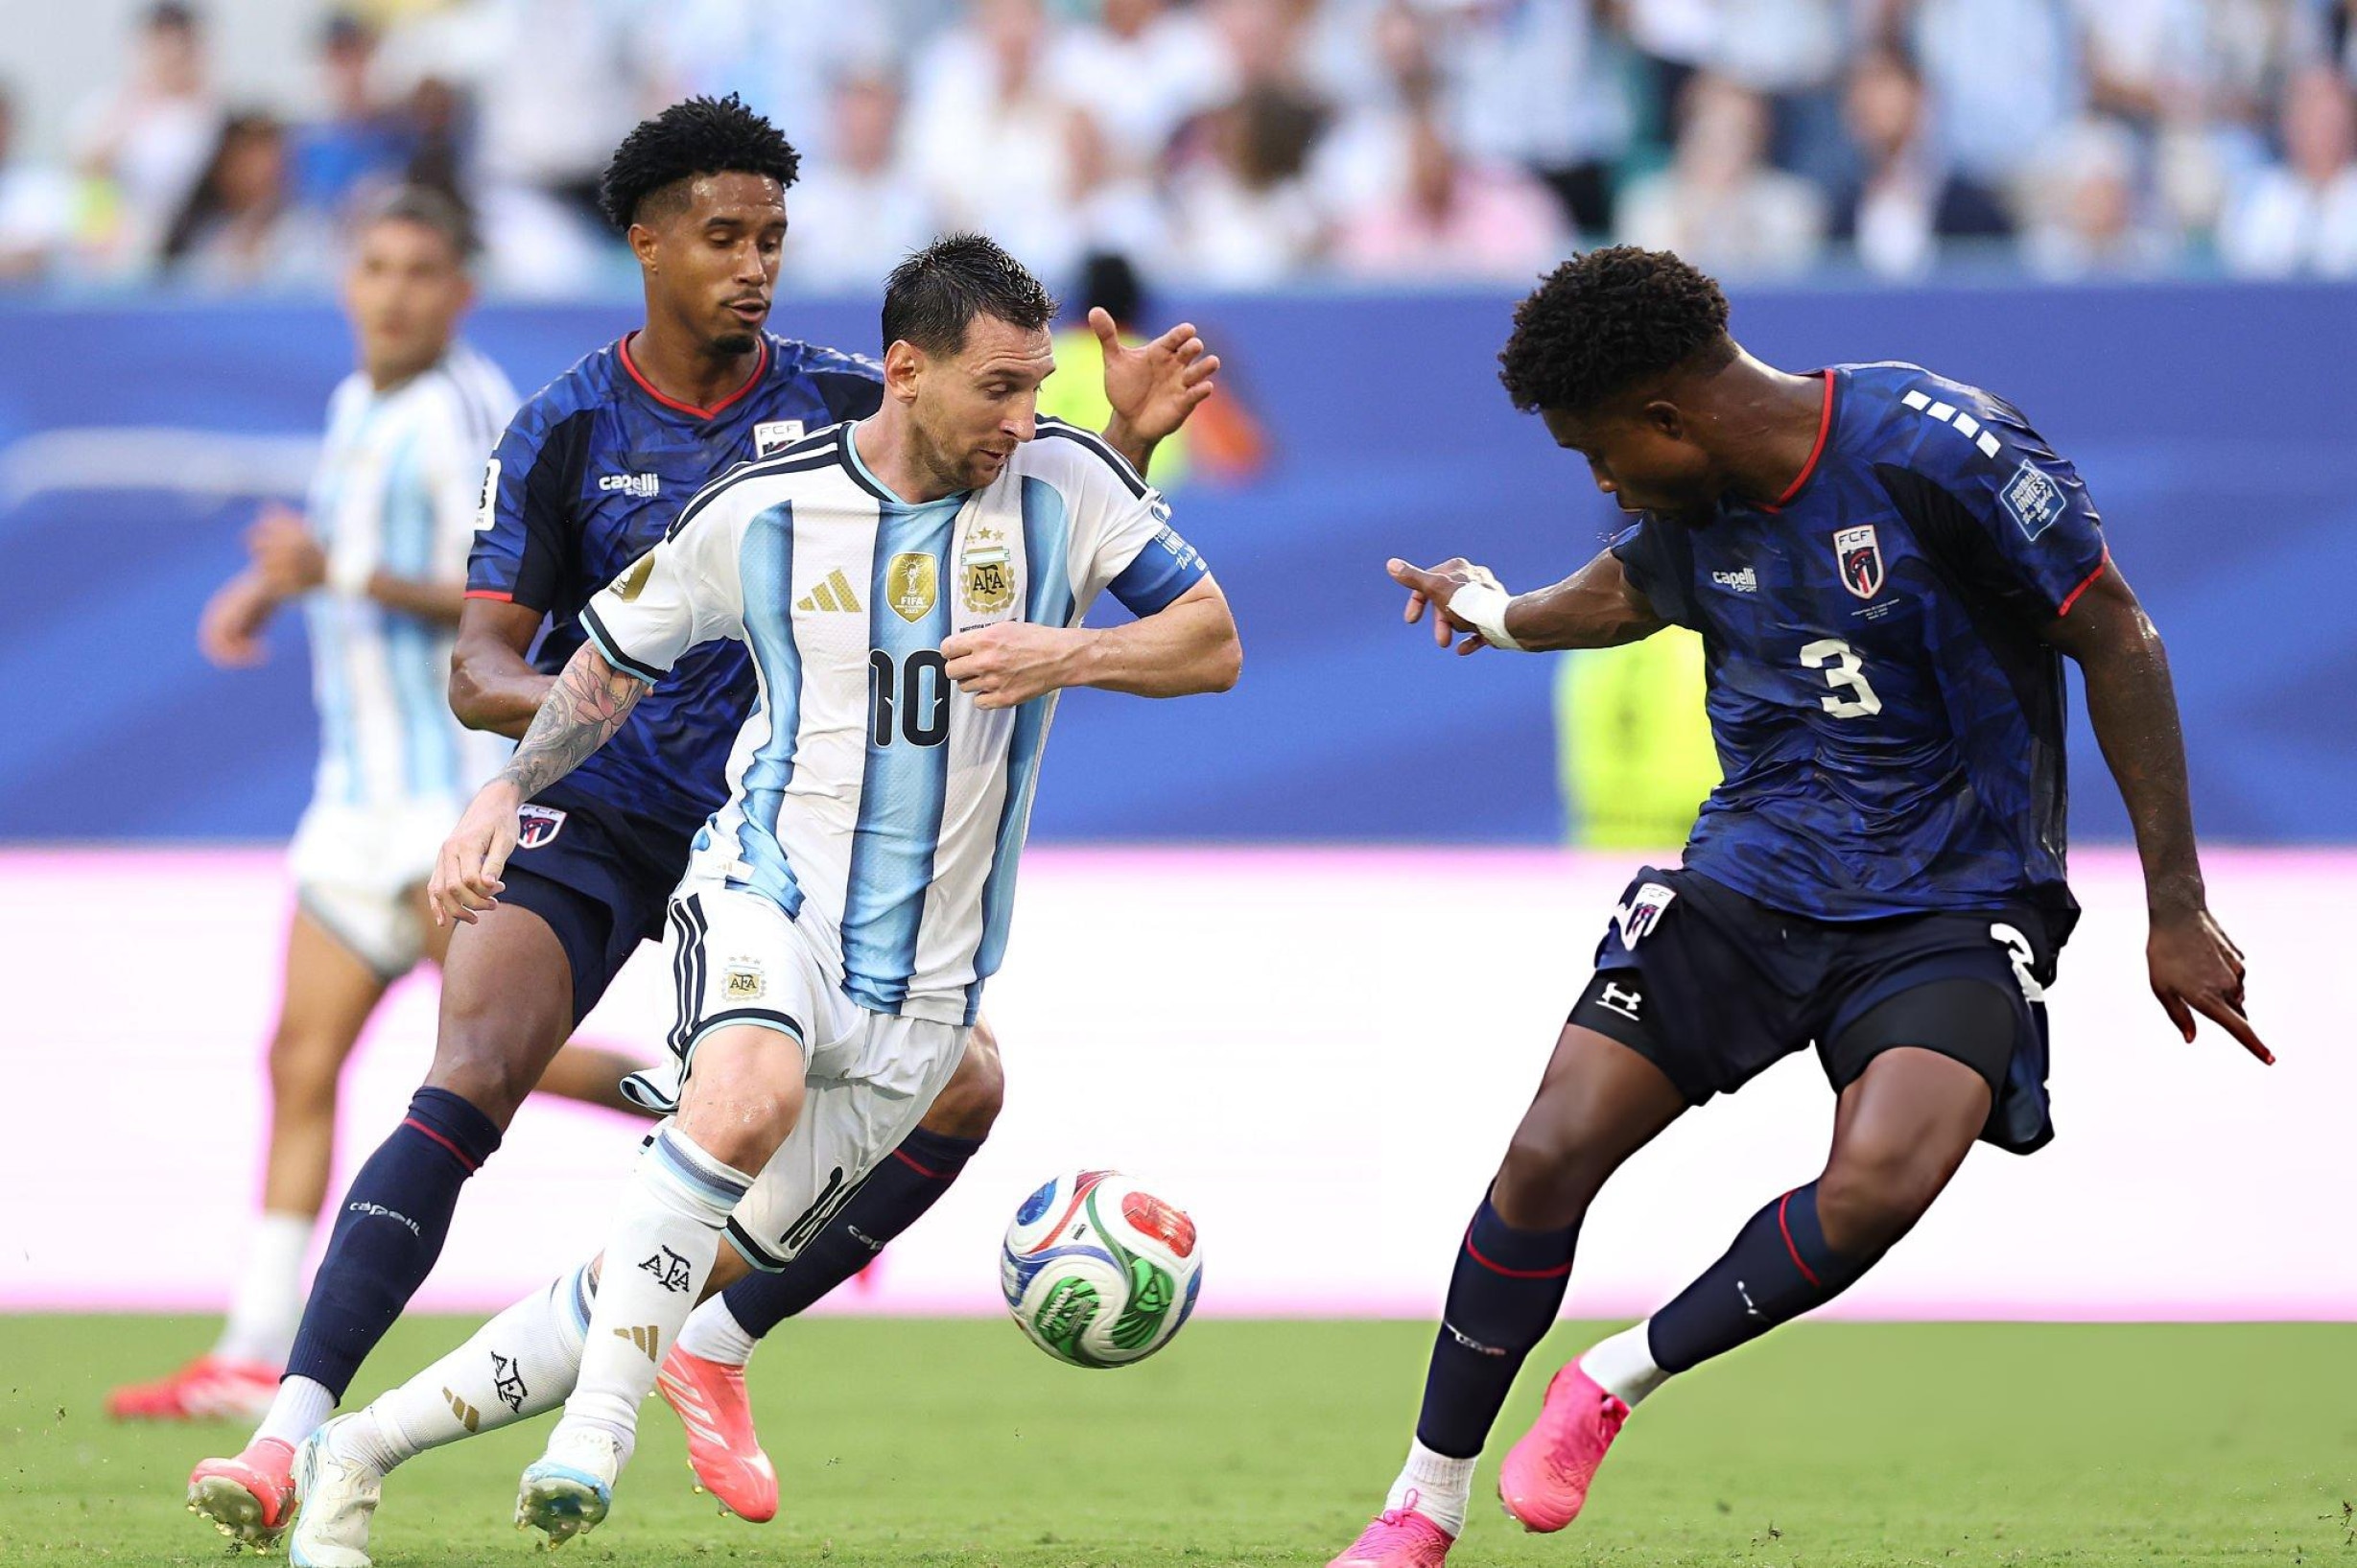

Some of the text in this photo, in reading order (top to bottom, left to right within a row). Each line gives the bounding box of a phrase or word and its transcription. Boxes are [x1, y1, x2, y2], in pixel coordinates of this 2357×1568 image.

[599, 474, 659, 490] capelli
[1839, 529, 1871, 546] FCF
[972, 565, 1004, 595] AFA
[1712, 567, 1756, 590] capelli
[901, 597, 924, 605] FIFA
[1800, 638, 1882, 719] 3
[869, 648, 951, 748] 10
[730, 972, 758, 991] AFA
[638, 1244, 691, 1293] AFA
[490, 1350, 528, 1414] AFA
